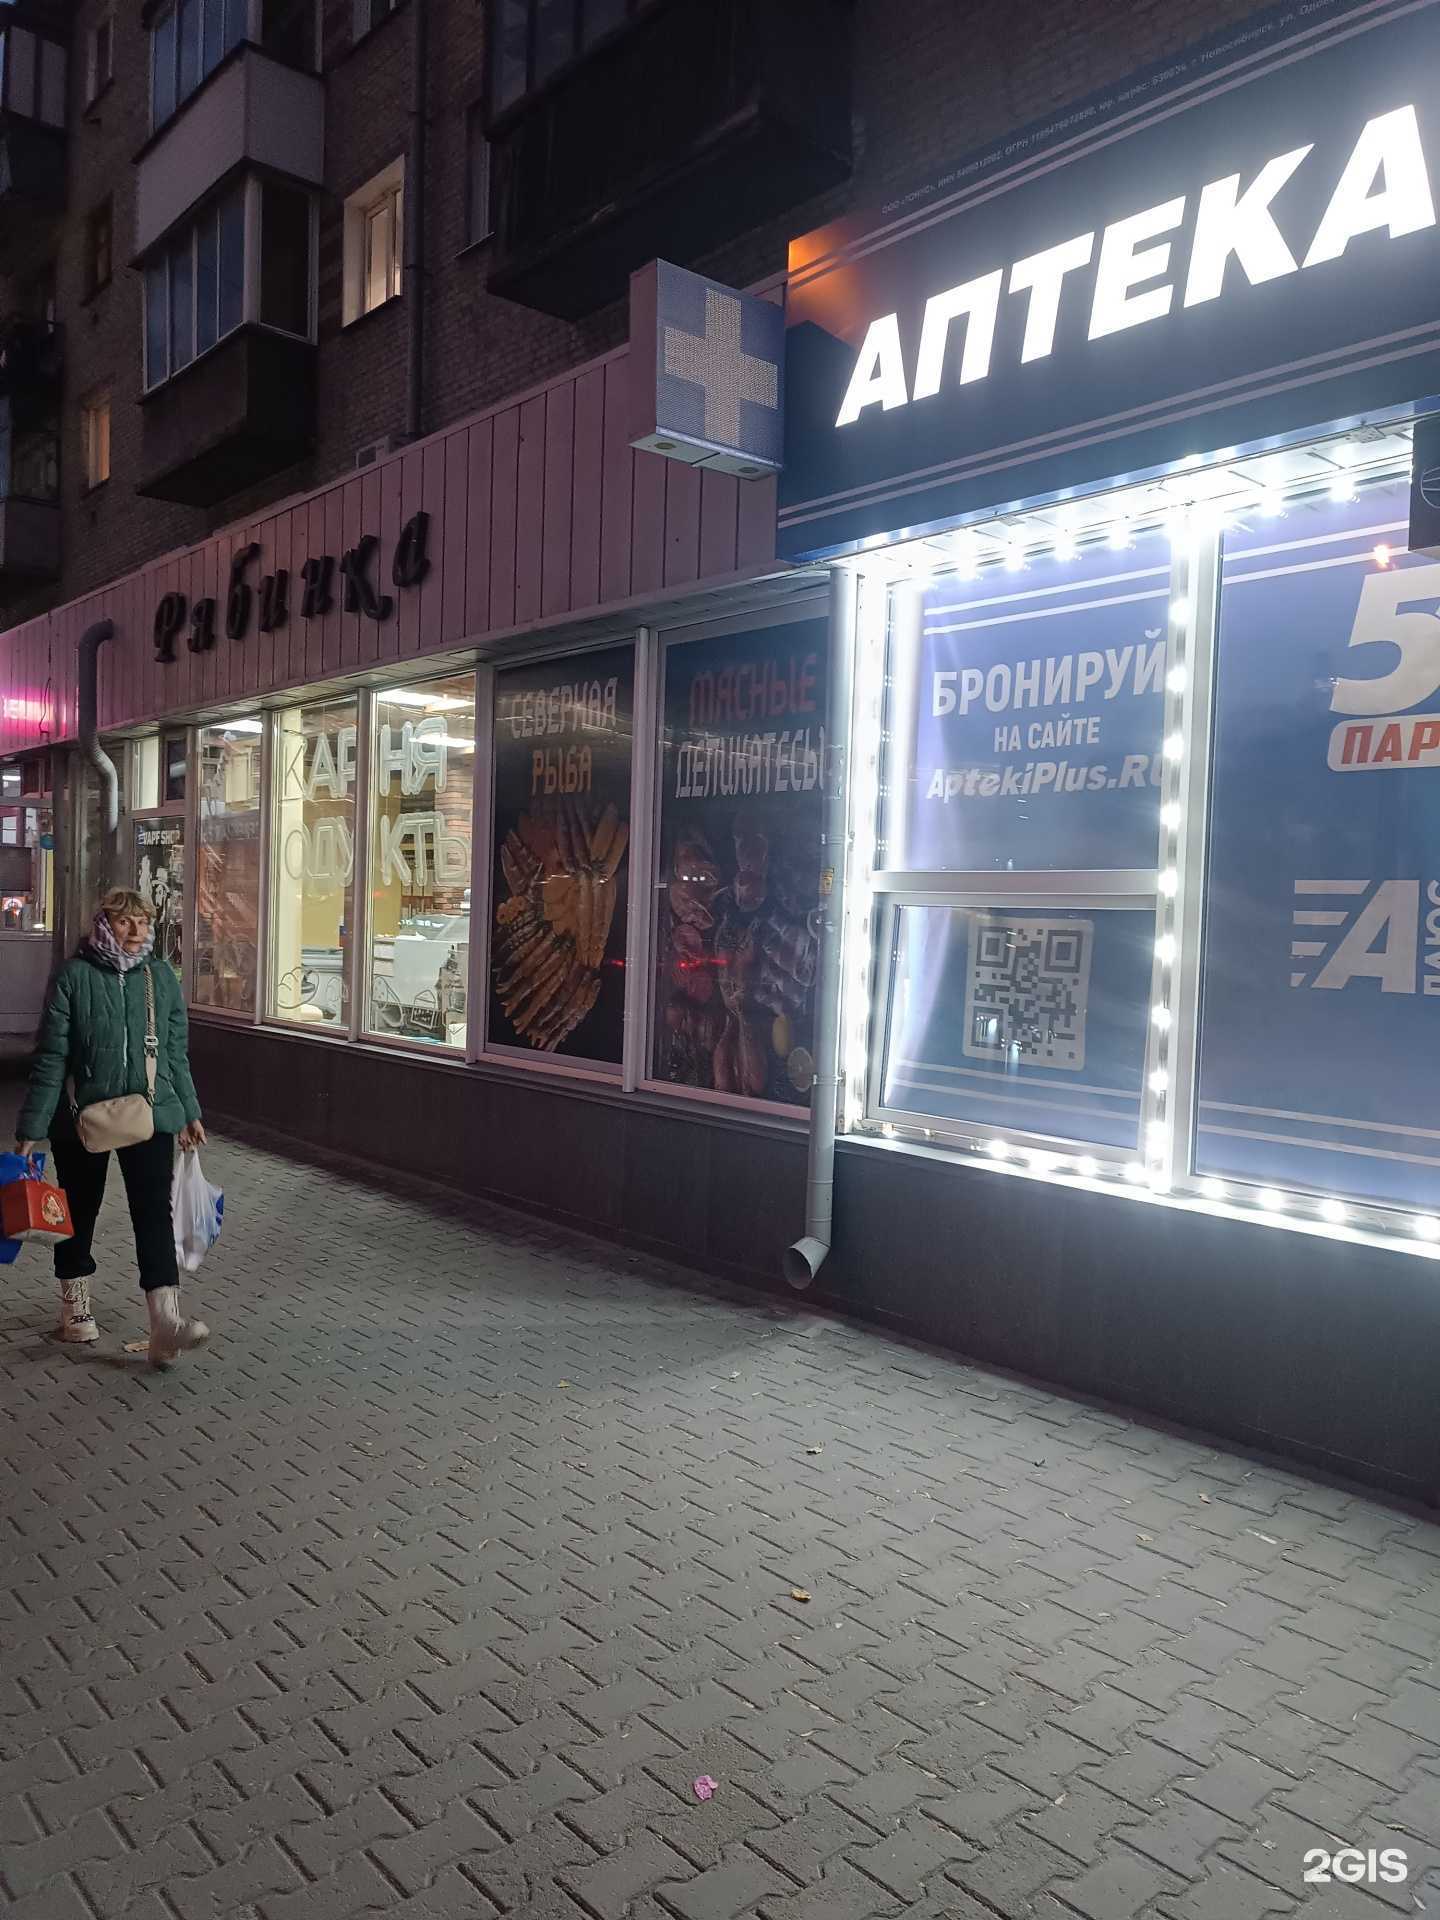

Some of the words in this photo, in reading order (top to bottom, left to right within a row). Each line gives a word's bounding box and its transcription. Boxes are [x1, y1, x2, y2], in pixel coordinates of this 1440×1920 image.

[835, 103, 1437, 428] АПТЕКА
[152, 511, 431, 663] Рябинка
[511, 677, 618, 739] СЕВЕРНАЯ
[689, 655, 817, 727] МЯСНЫЕ
[932, 628, 1168, 717] БРОНИРУЙ
[675, 726, 825, 798] ДЕЛИКАТЕСЫ
[993, 724, 1021, 752] НА
[1028, 713, 1101, 750] САЙТЕ
[532, 745, 592, 796] РЫБА
